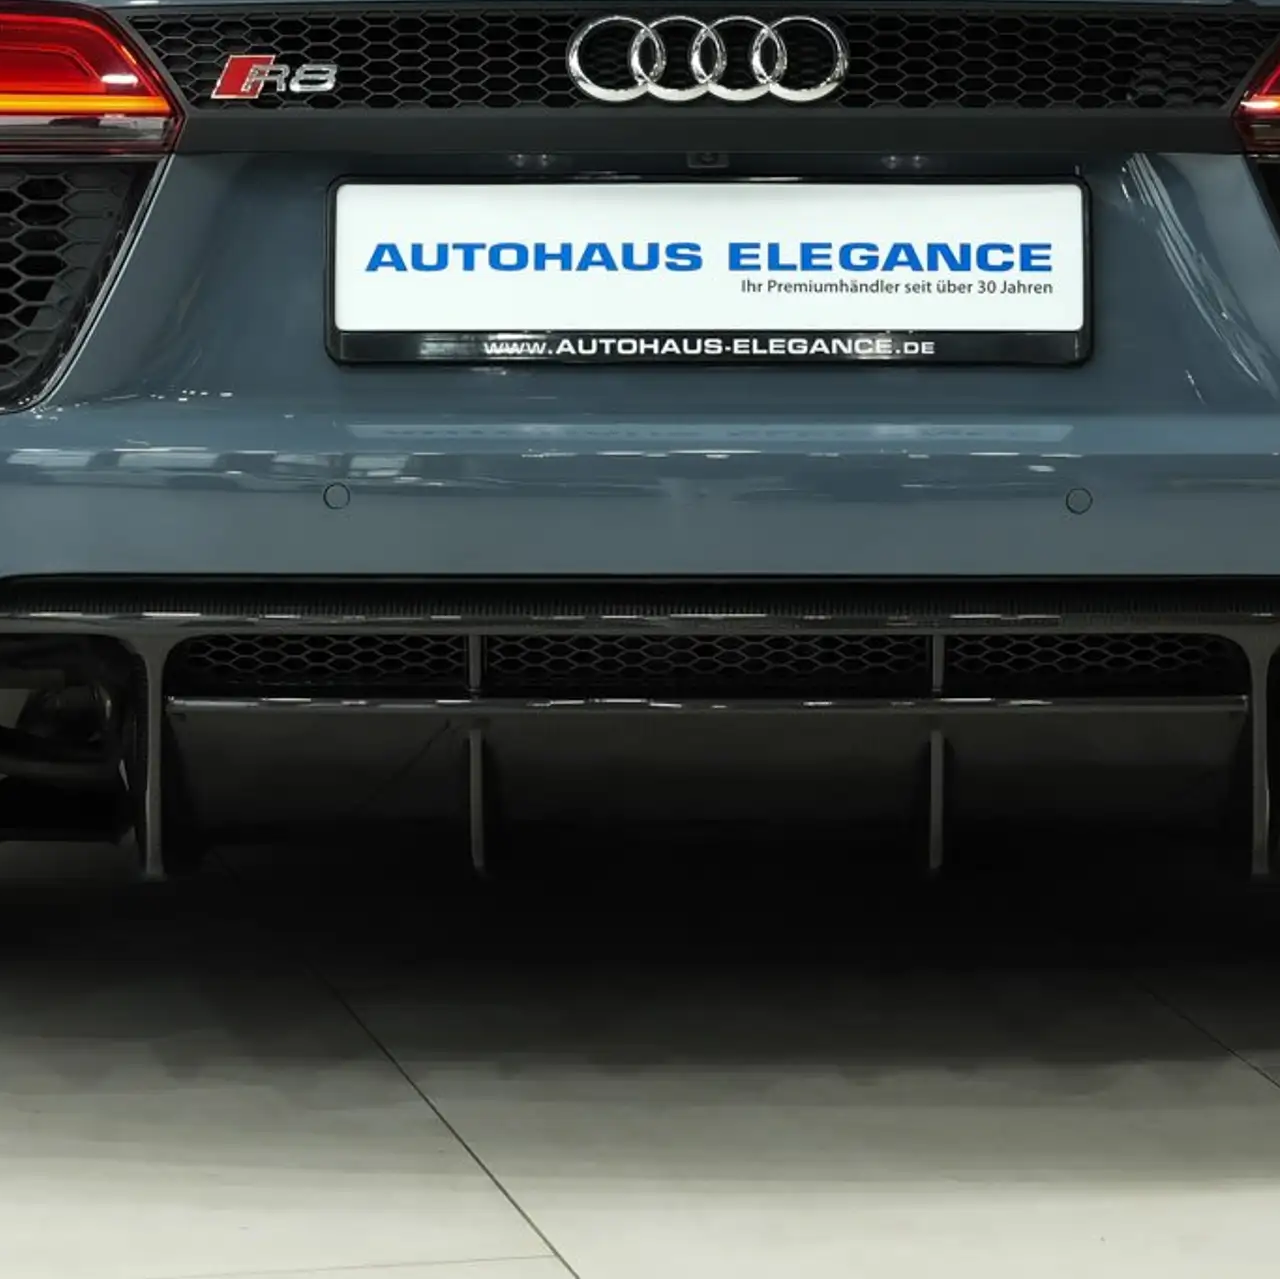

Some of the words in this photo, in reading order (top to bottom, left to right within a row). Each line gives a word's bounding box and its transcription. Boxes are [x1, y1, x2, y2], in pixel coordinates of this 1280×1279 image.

[239, 63, 339, 93] R8
[365, 241, 704, 272] AUTOHAUS
[728, 241, 1053, 272] ELEGANCE
[740, 279, 763, 294] Ihr
[767, 279, 900, 294] Premiumhändler
[904, 280, 932, 294] seit
[936, 279, 973, 294] über
[977, 280, 997, 294] 30
[999, 279, 1053, 295] Jahren
